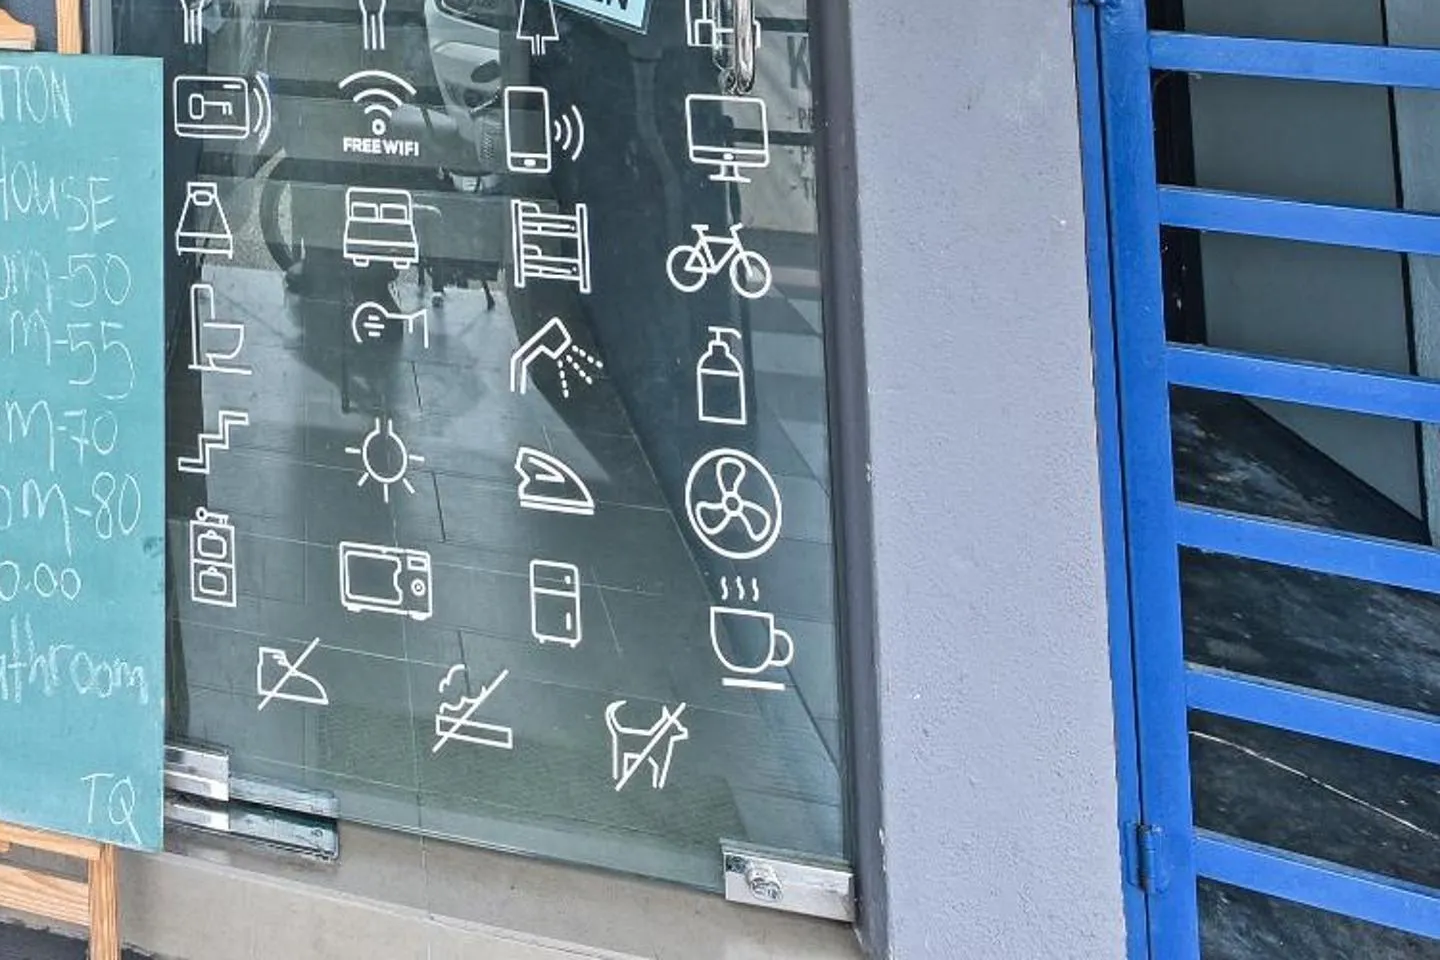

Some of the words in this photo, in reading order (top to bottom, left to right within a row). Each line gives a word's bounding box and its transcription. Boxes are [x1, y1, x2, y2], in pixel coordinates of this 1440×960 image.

[342, 136, 382, 155] FREE
[382, 139, 420, 157] WIFI
[79, 772, 143, 844] TQ
